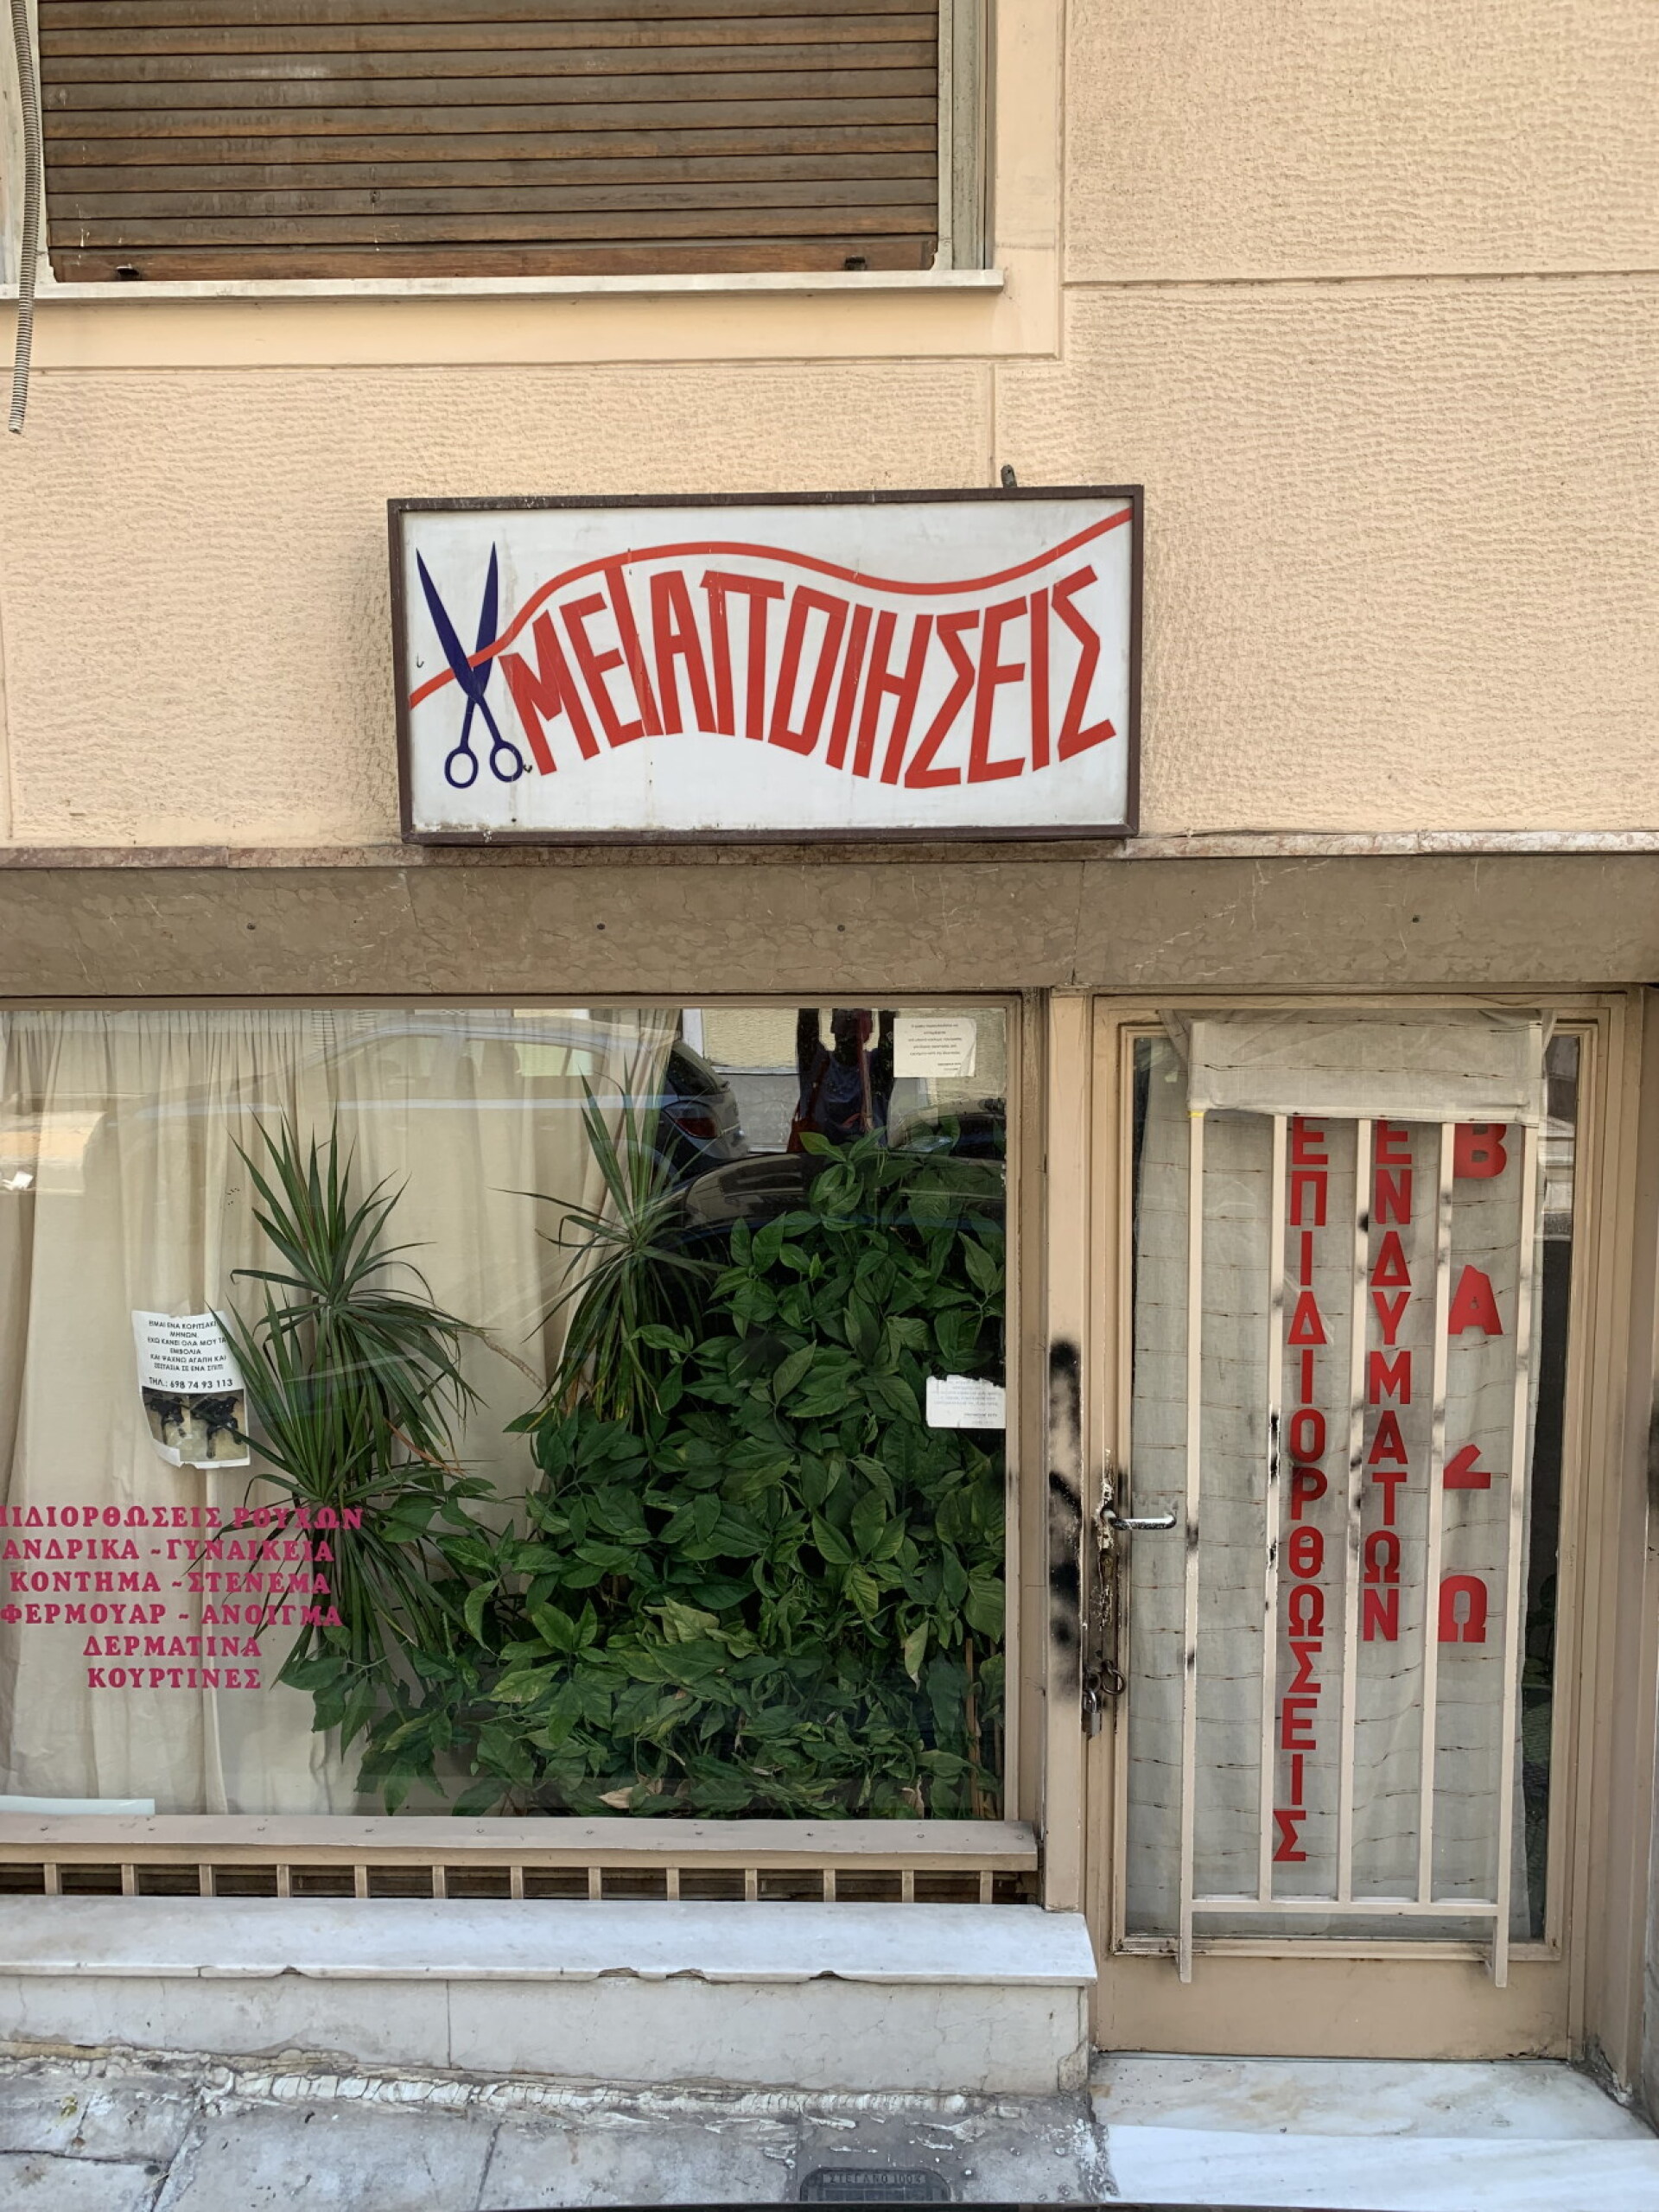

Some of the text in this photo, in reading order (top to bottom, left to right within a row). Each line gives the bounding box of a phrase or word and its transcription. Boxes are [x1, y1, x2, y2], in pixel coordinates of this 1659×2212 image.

[188, 1381, 199, 1389] 74
[216, 1378, 233, 1389] 113
[1363, 1119, 1413, 1642] ΕΝΔΥΜΑΤΩΝ
[1273, 1117, 1328, 1861] ΕΠΙΔΙΟΡΘΩΣΕΙΣ
[233, 1507, 364, 1530] ΡΟΥΧΩΝ
[3, 1538, 140, 1560] ΑΝΔΡΙΚΑ
[10, 1570, 162, 1593] ΚΟΝΤΗΜΑ
[0, 1603, 167, 1624] ΦΕΡΜΟΥΑΡ
[201, 1604, 344, 1627] ΑΝΟΙΓΜΑ
[83, 1636, 263, 1656] ΔΕΡΜΑΤΙΝΑ
[87, 1668, 262, 1688] ΚΟΥΡΤΙΝΕΣ
